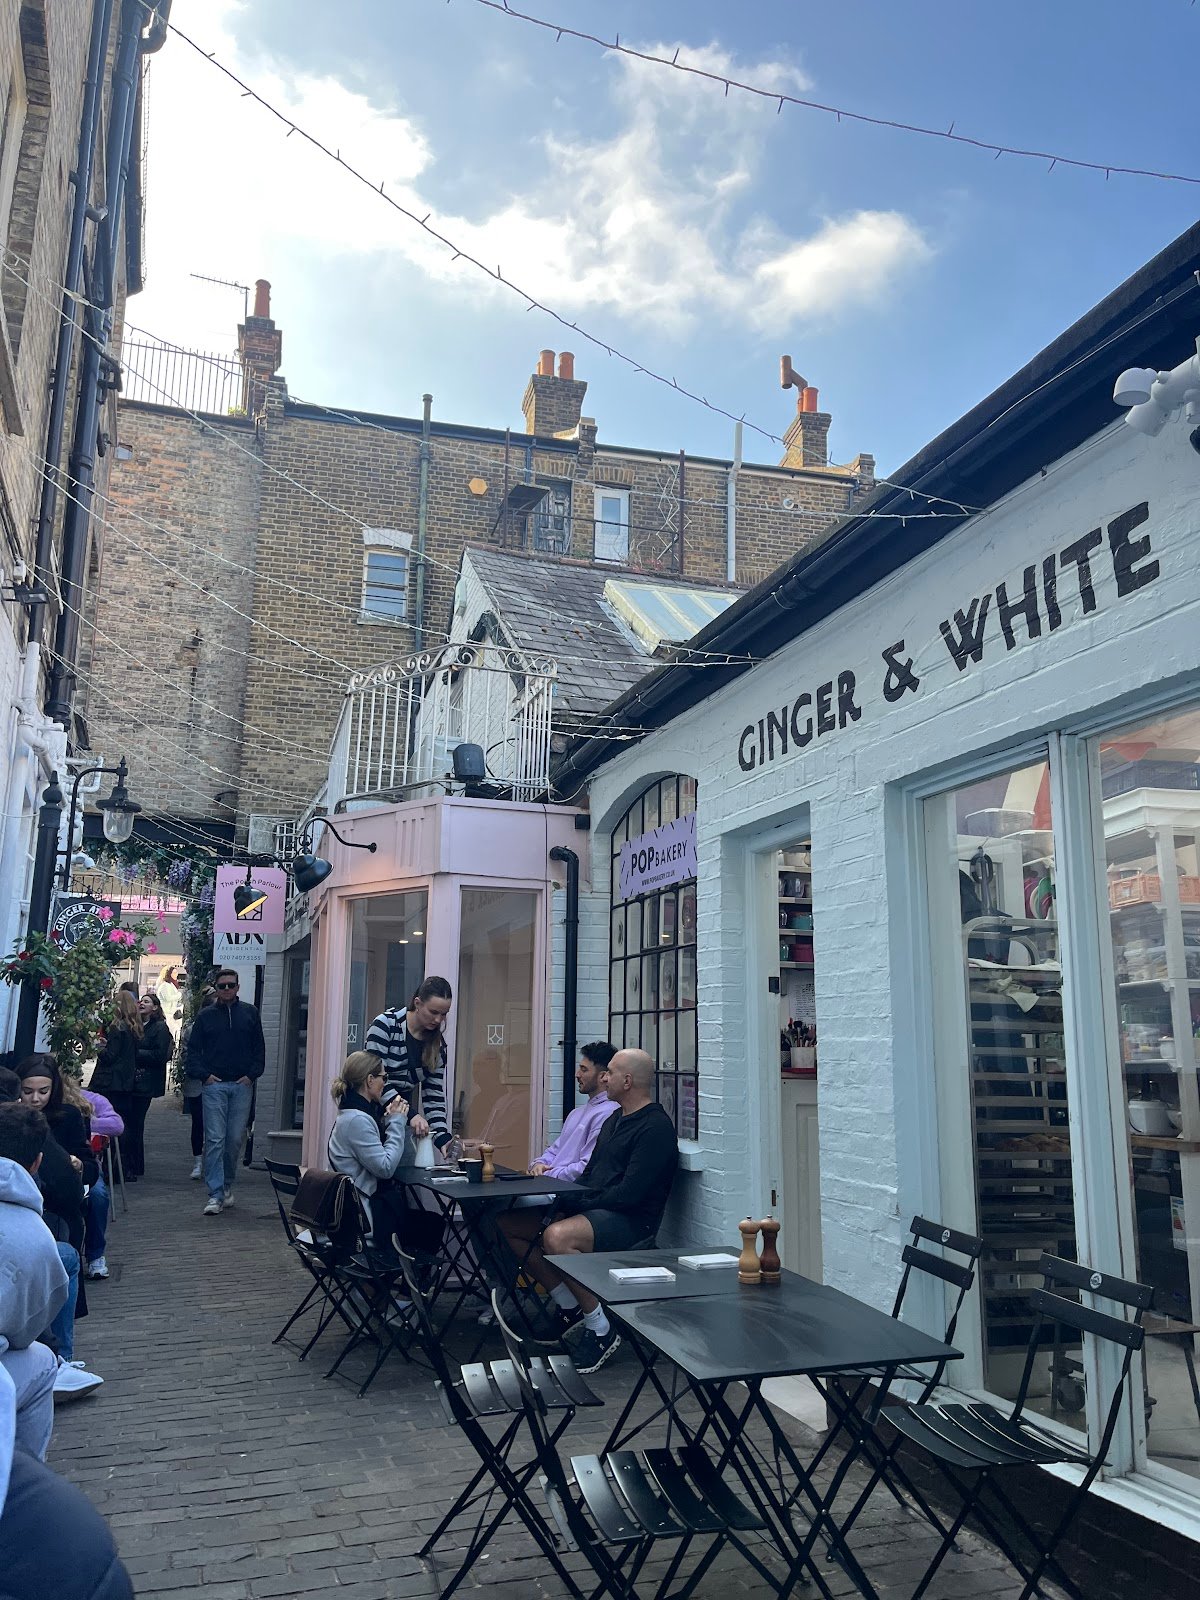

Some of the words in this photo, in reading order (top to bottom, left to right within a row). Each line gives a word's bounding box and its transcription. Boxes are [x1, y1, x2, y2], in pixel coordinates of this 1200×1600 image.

[738, 670, 861, 771] GINGER
[882, 640, 920, 702] &
[939, 502, 1160, 671] WHITE
[257, 879, 282, 889] Parlour
[641, 870, 676, 886] WWW.POPBAKERY.CO.UK
[55, 904, 86, 932] GINGER
